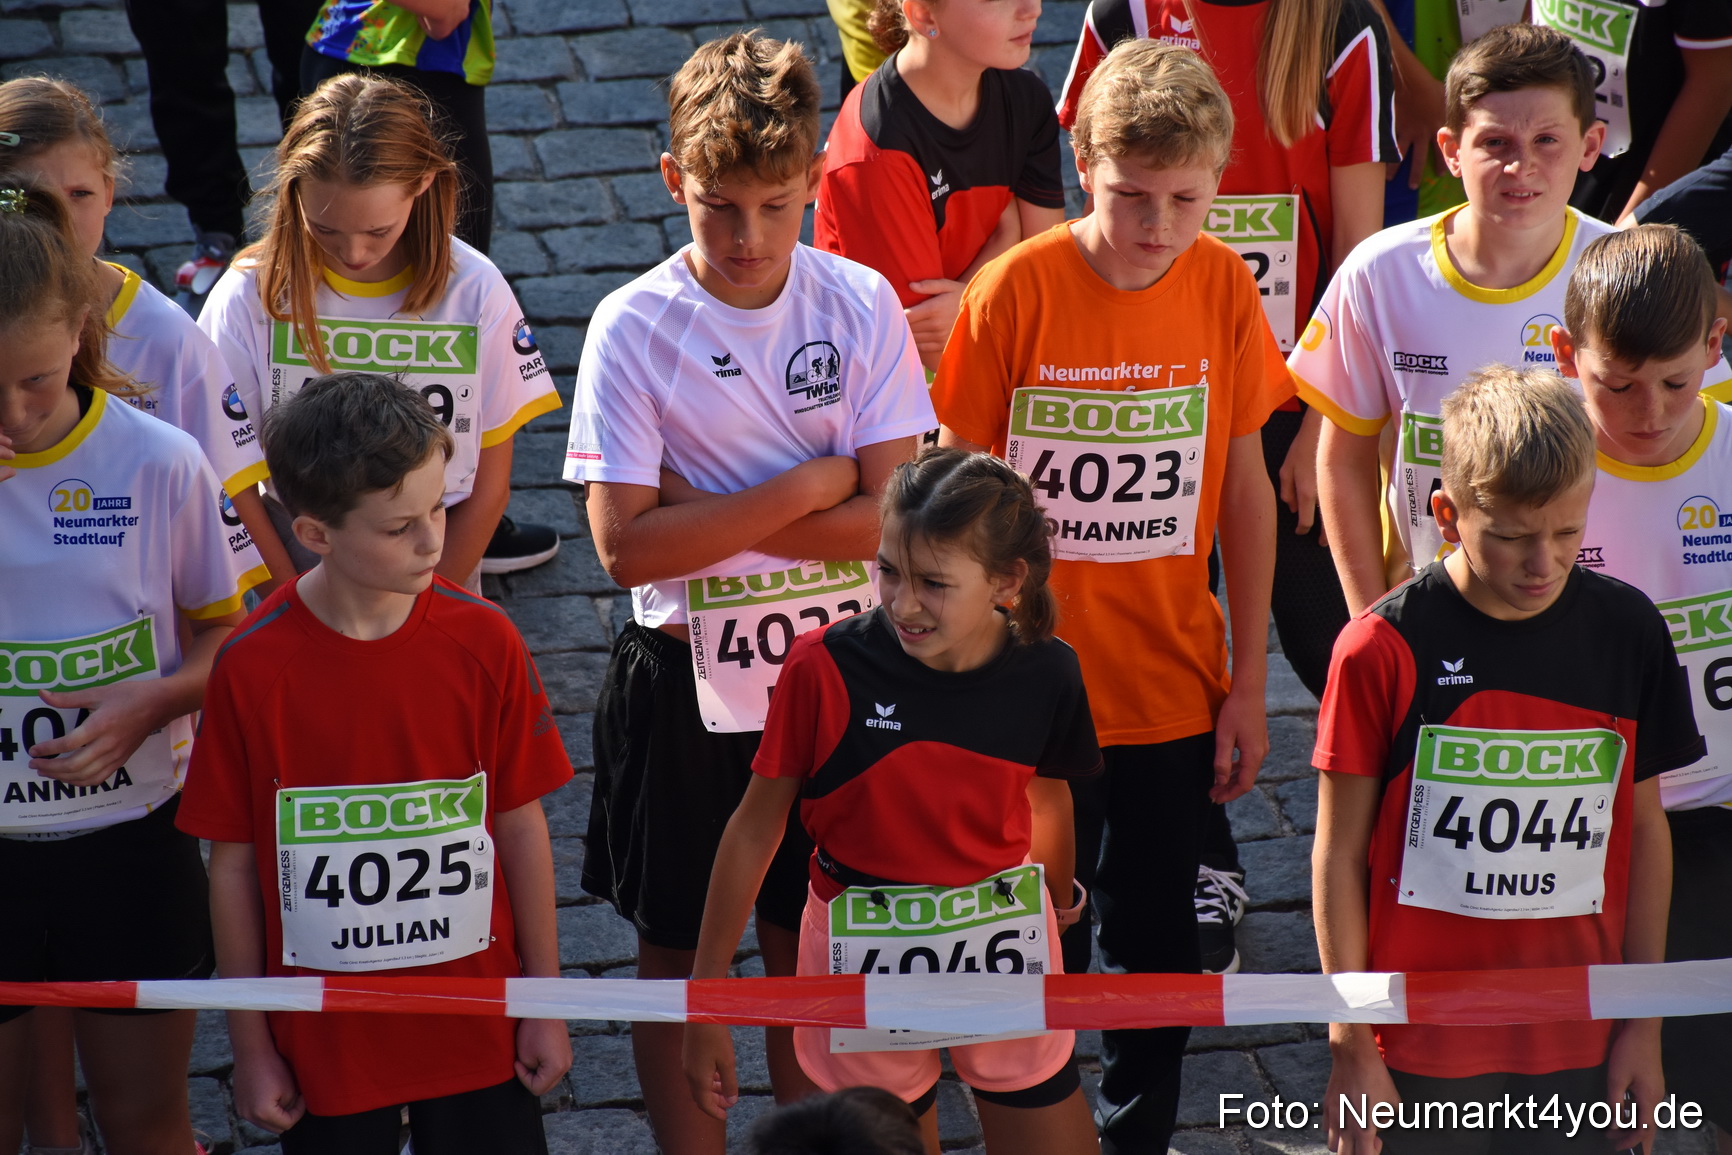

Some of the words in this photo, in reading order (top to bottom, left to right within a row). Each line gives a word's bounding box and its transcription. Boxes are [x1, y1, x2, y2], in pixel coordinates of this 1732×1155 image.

[932, 183, 950, 200] erima
[712, 368, 742, 378] rima
[1039, 362, 1162, 381] Neumarkter
[1394, 352, 1448, 370] BOCK
[1026, 394, 1193, 437] BOCK
[1030, 450, 1181, 503] 4023
[54, 489, 91, 512] 20
[96, 499, 129, 509] JAHRE
[54, 515, 139, 528] Neumarkter
[1046, 516, 1178, 542] OHANNES
[1682, 505, 1716, 530] 20
[54, 532, 125, 547] Stadtlauf
[1437, 673, 1474, 686] erima
[866, 718, 902, 731] erima
[1432, 735, 1605, 781] BOCK
[295, 786, 473, 838] BOCK
[1433, 796, 1591, 853] 4044
[305, 840, 472, 908] 4025
[1465, 871, 1556, 896] LINUS
[847, 874, 1028, 930] BOCK
[331, 917, 450, 950] JULIAN
